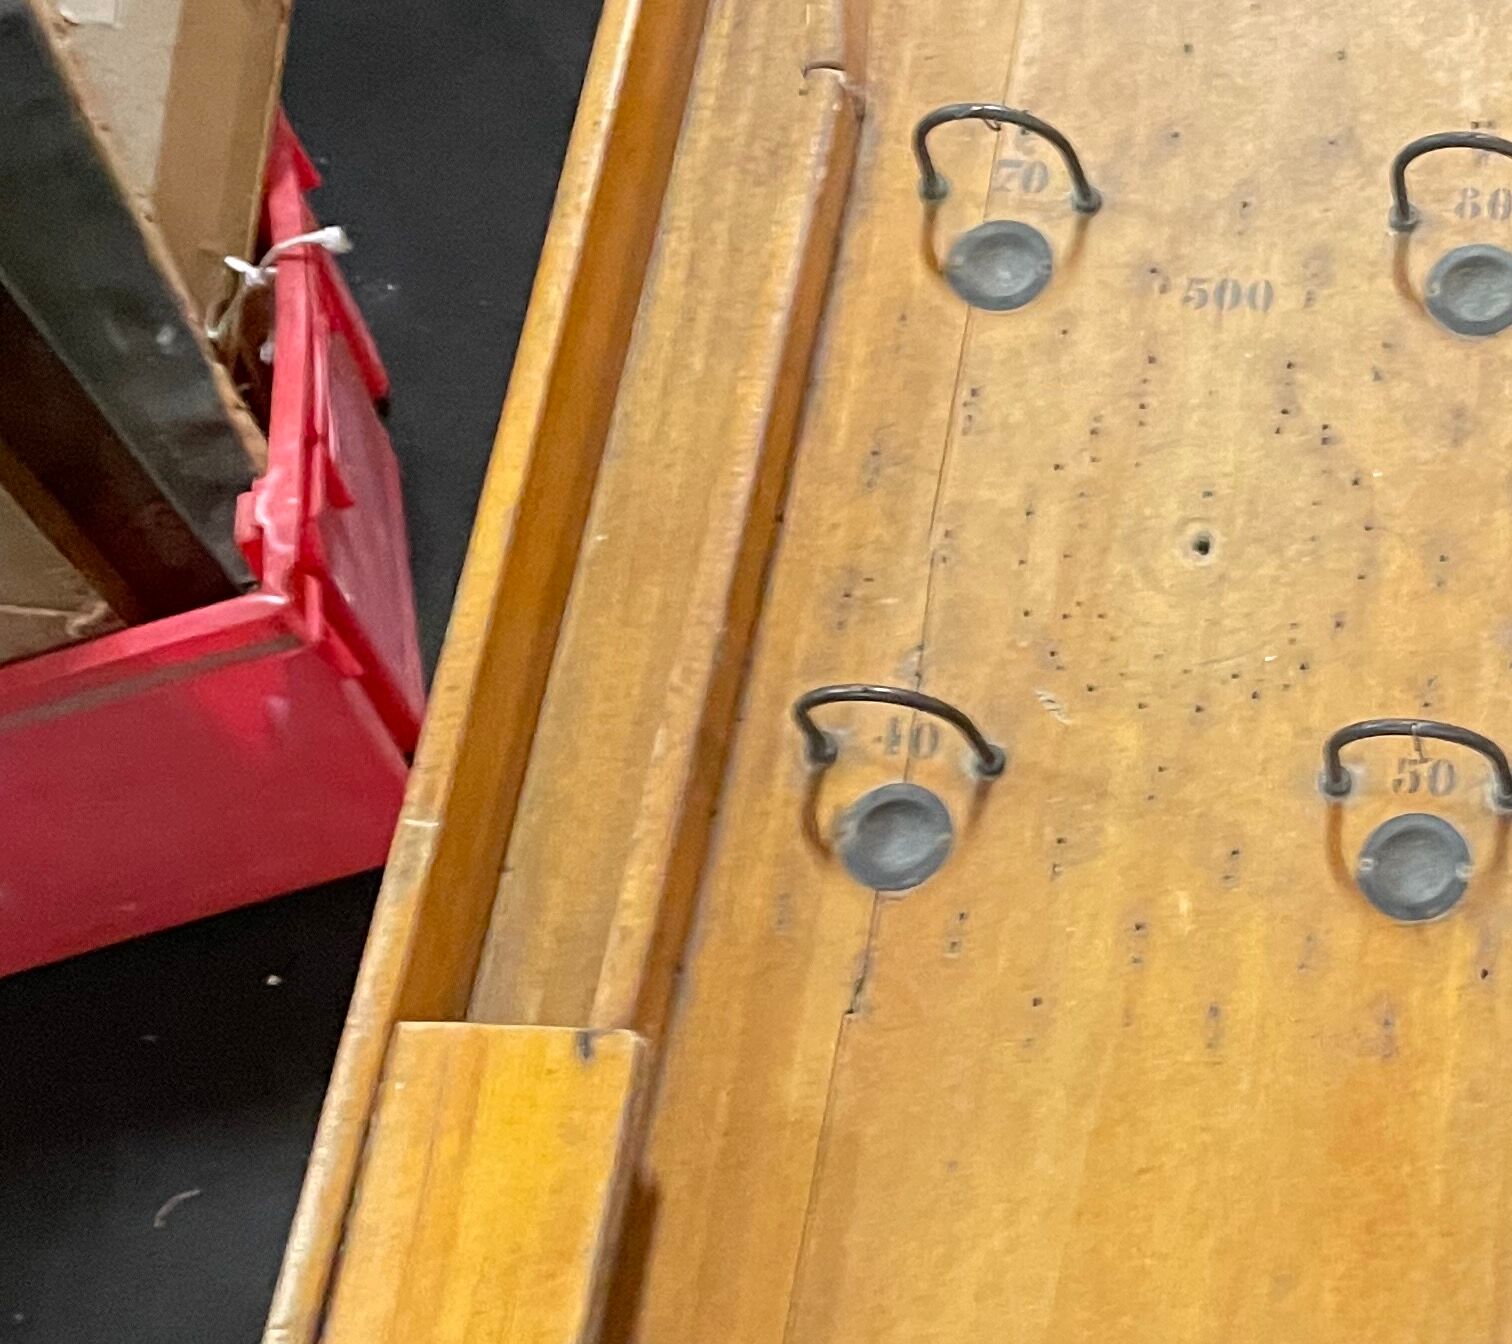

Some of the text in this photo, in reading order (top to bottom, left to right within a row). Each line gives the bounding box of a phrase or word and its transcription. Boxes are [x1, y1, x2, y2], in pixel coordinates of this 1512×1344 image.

[992, 158, 1050, 194] 70
[1454, 186, 1512, 223] 80
[1182, 276, 1275, 314] 500
[1391, 756, 1457, 797] 50
